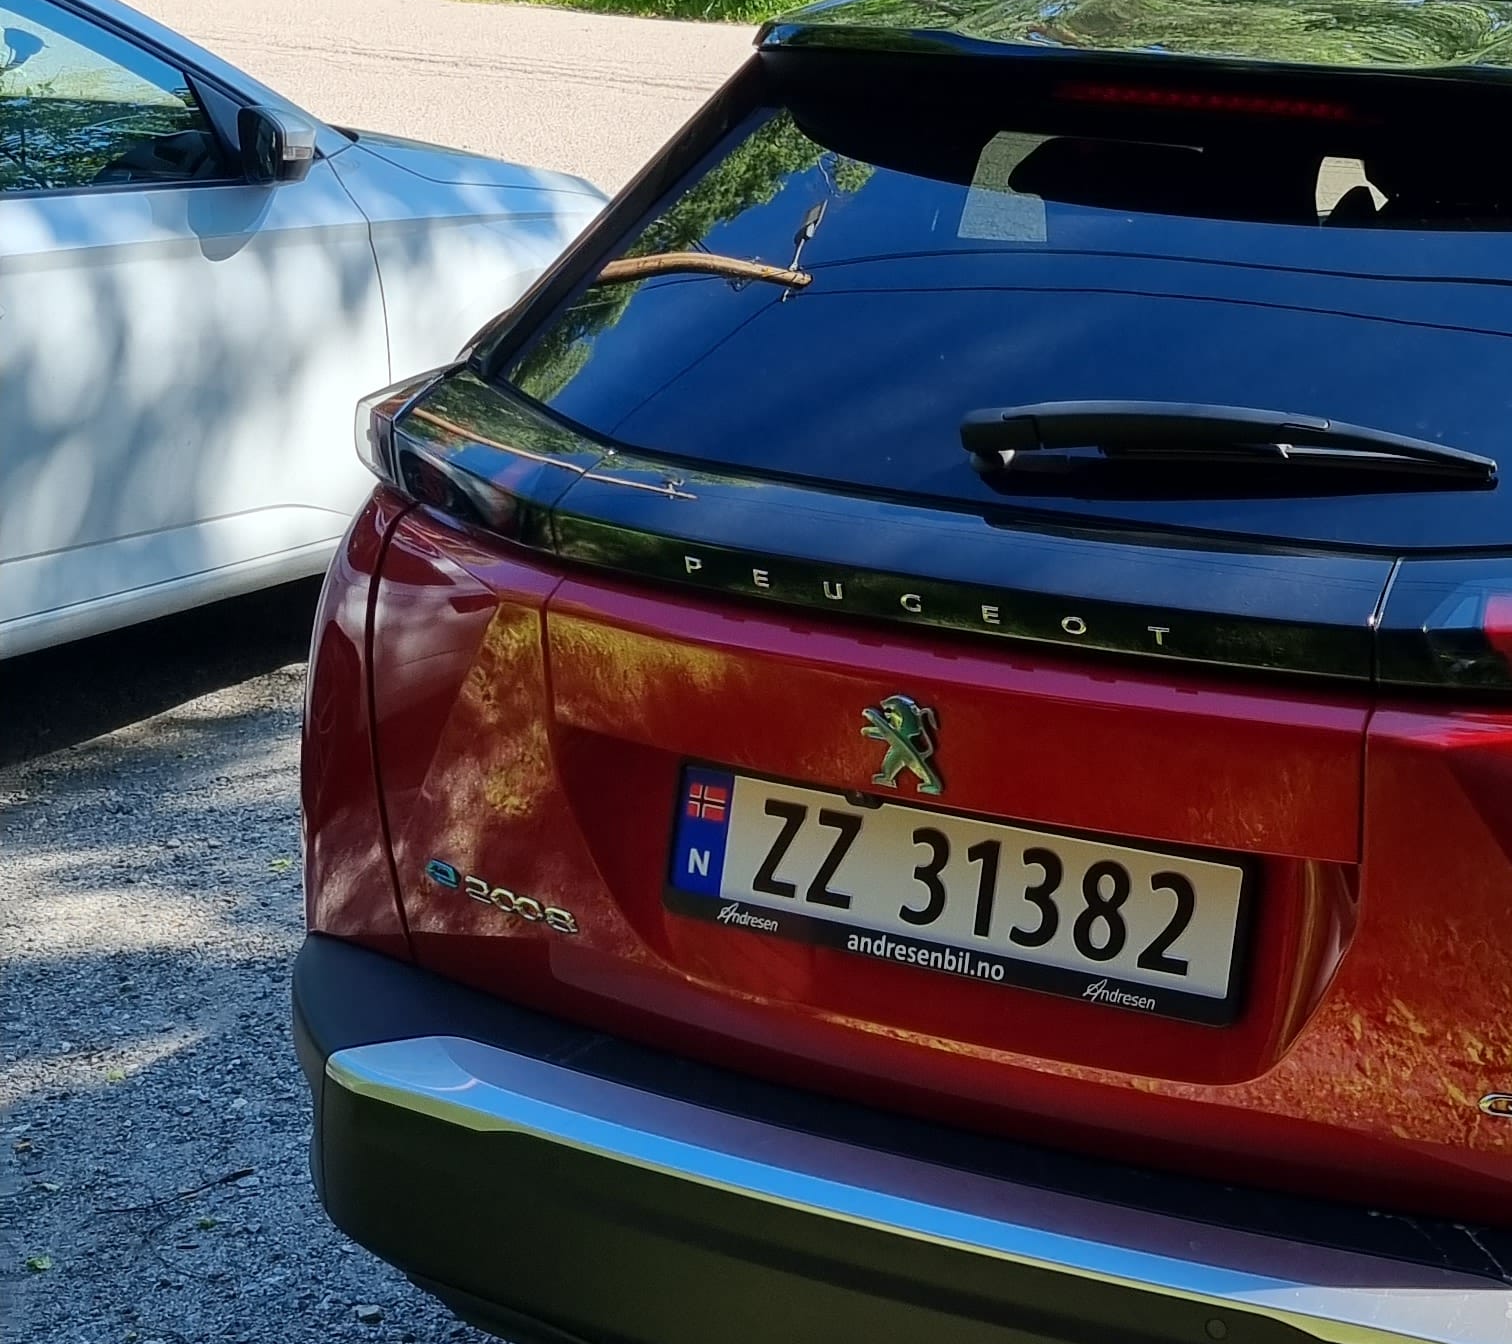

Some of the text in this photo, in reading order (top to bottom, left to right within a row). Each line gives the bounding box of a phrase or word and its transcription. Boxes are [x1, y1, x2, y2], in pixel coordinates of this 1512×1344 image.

[685, 555, 1170, 645] PEUGEOT
[687, 849, 711, 877] N
[752, 798, 1197, 977] ZZ 31382
[716, 902, 778, 932] Andresen
[846, 932, 1005, 981] andresenbil.no
[1082, 978, 1156, 1011] Andresen
